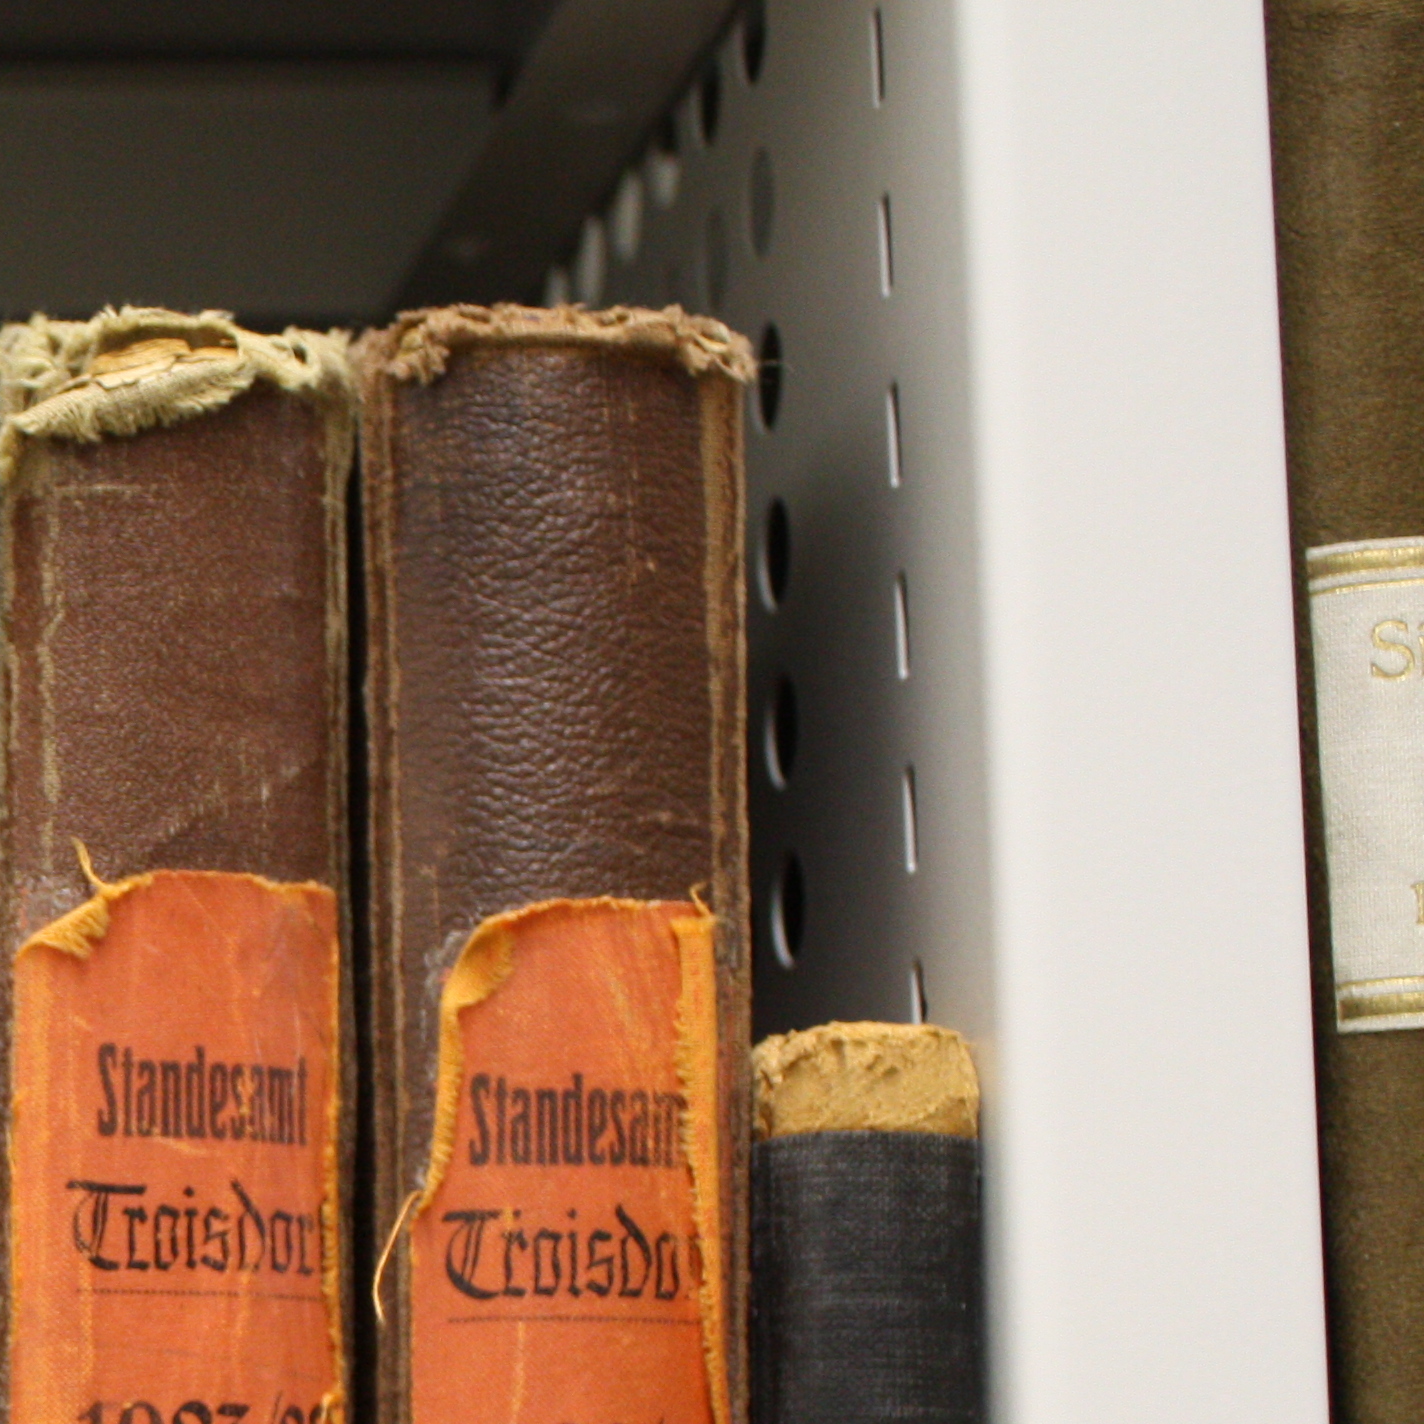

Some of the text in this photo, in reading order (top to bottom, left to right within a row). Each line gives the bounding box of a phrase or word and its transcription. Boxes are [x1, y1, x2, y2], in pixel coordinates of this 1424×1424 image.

[97, 1042, 307, 1146] Standesamt
[66, 1178, 323, 1278] Troisdor
[442, 1203, 701, 1301] Troisdo
